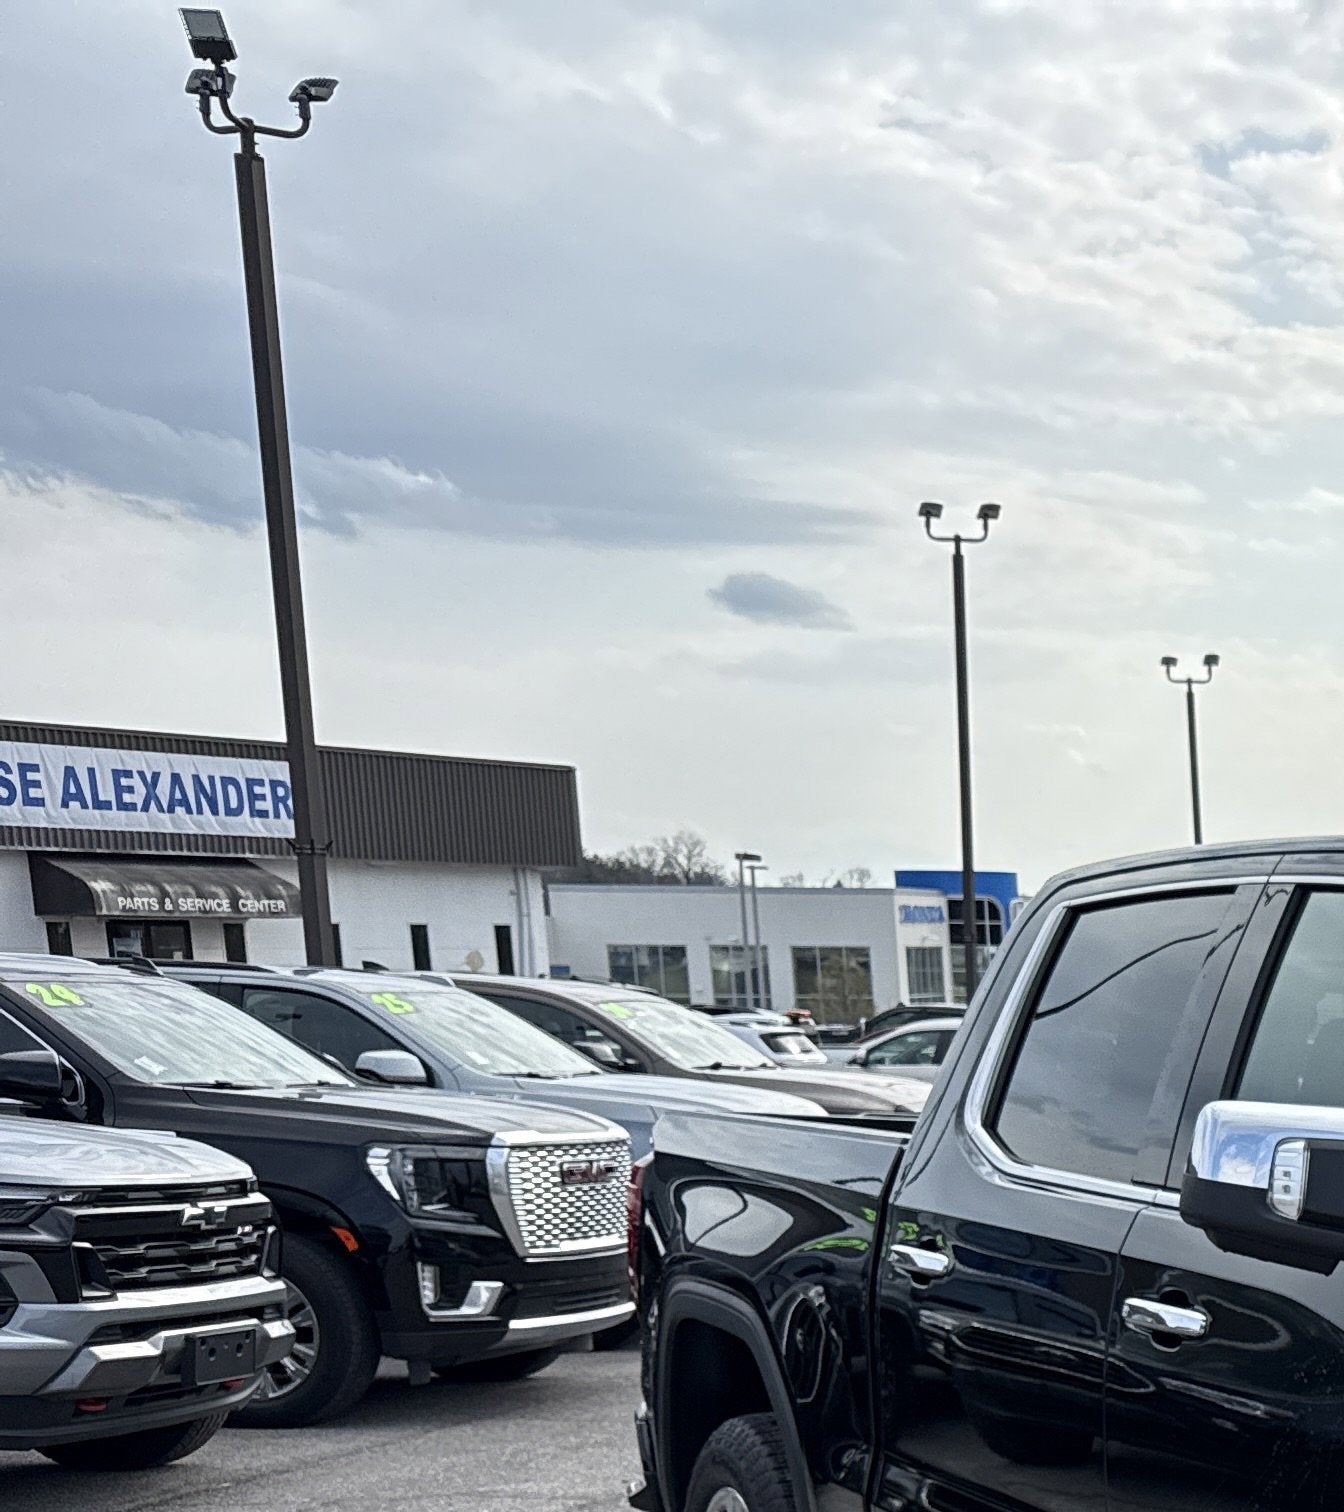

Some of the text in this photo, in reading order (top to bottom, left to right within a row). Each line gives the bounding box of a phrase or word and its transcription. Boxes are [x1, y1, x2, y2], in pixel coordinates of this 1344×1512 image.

[61, 766, 293, 819] ALEXANDER
[118, 897, 286, 912] PARTS & SERVICE CENTER
